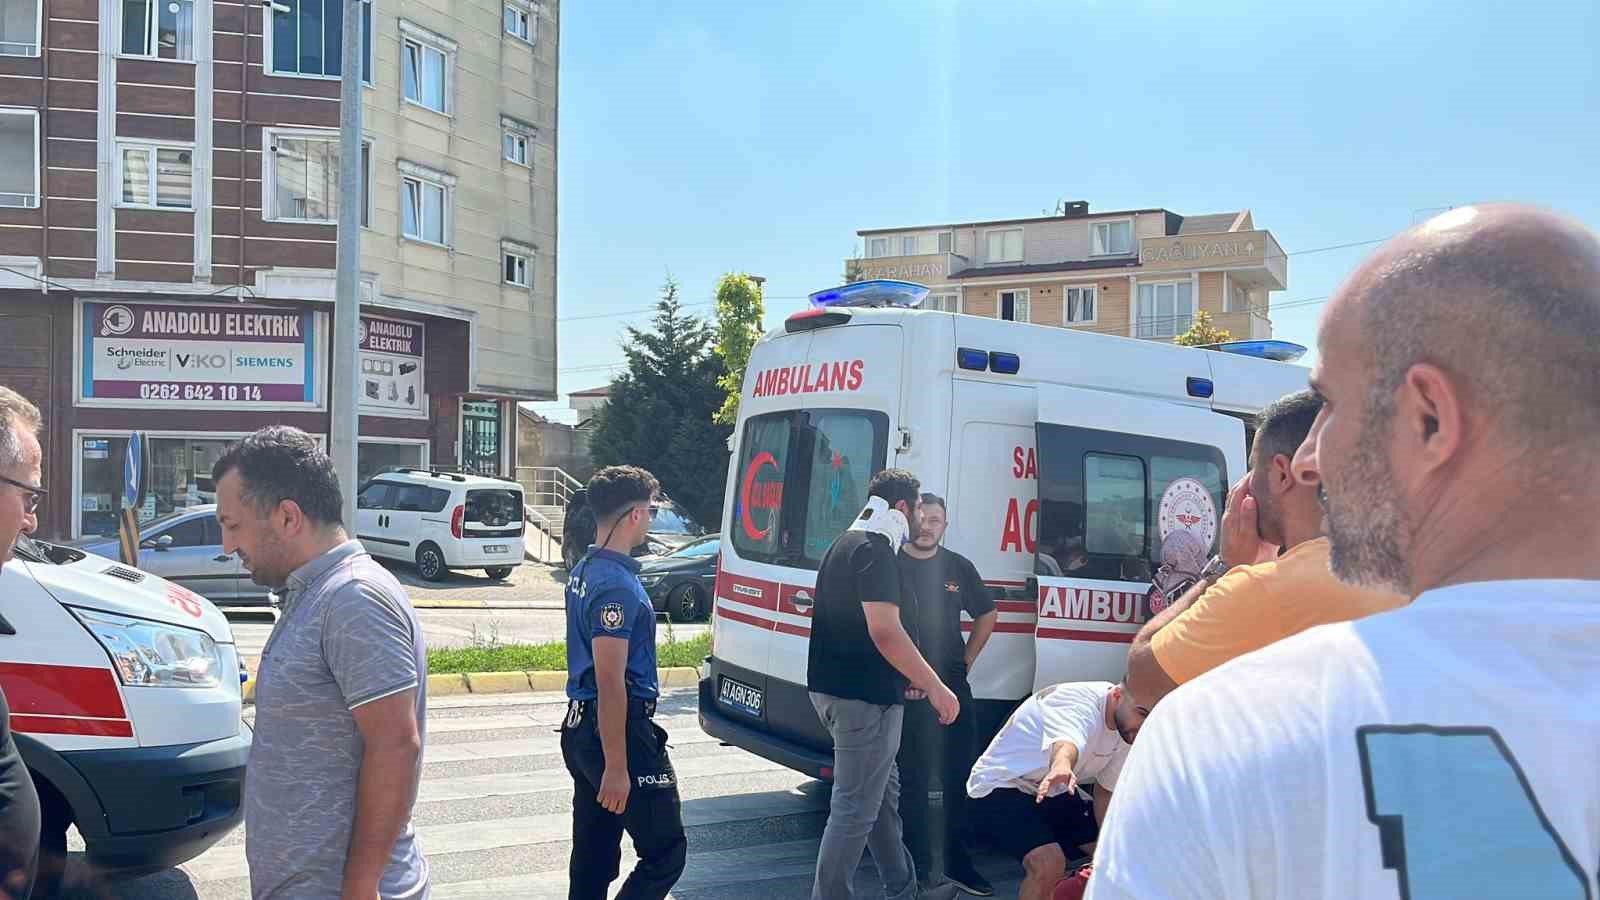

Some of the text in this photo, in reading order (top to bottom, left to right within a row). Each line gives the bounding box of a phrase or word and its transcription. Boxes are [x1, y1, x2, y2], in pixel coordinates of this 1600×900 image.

[142, 311, 221, 334] ANADOLU
[370, 320, 413, 338] ANADOLU
[107, 346, 167, 358] Schneider
[134, 357, 166, 367] Electric
[236, 356, 293, 368] SIEMENS
[752, 359, 864, 398] AMBULANS
[140, 383, 262, 401] 0262 642 10 14
[1013, 446, 1040, 479] SA
[1000, 497, 1040, 554] AC
[1040, 586, 1147, 624] AMBUL
[746, 690, 761, 709] 306
